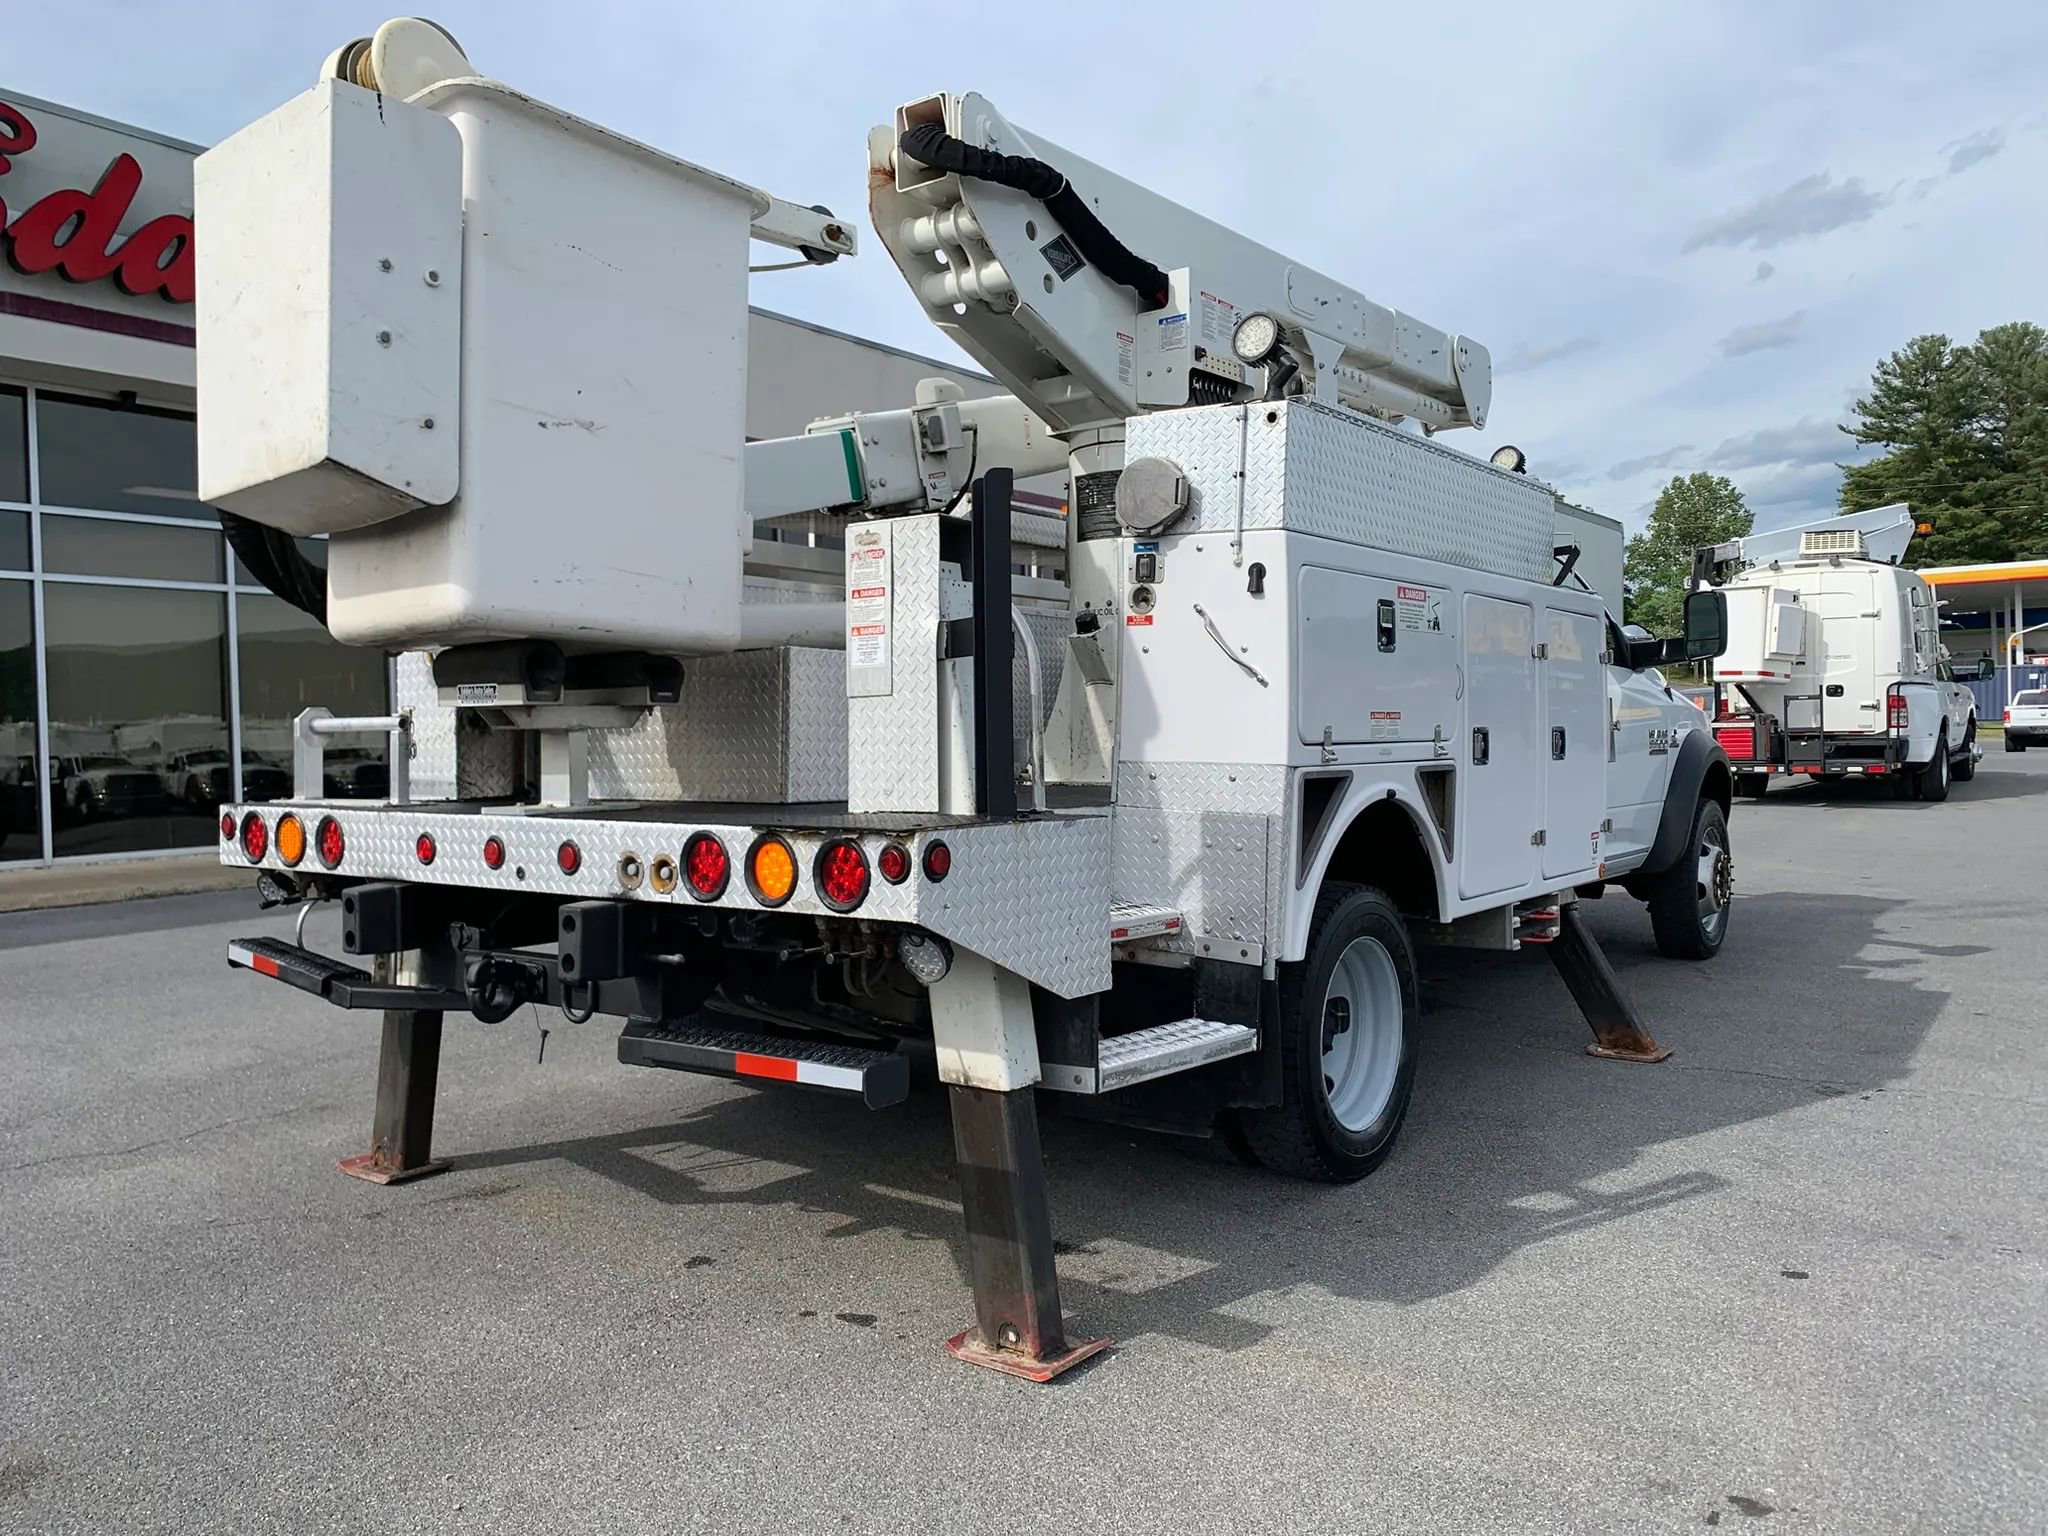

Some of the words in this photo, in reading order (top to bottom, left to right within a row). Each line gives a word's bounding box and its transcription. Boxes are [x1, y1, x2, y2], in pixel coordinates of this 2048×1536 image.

[860, 588, 884, 598] DANGER
[1405, 588, 1425, 601] DANGER
[1104, 607, 1115, 616] OIL
[859, 625, 884, 635] DANGER
